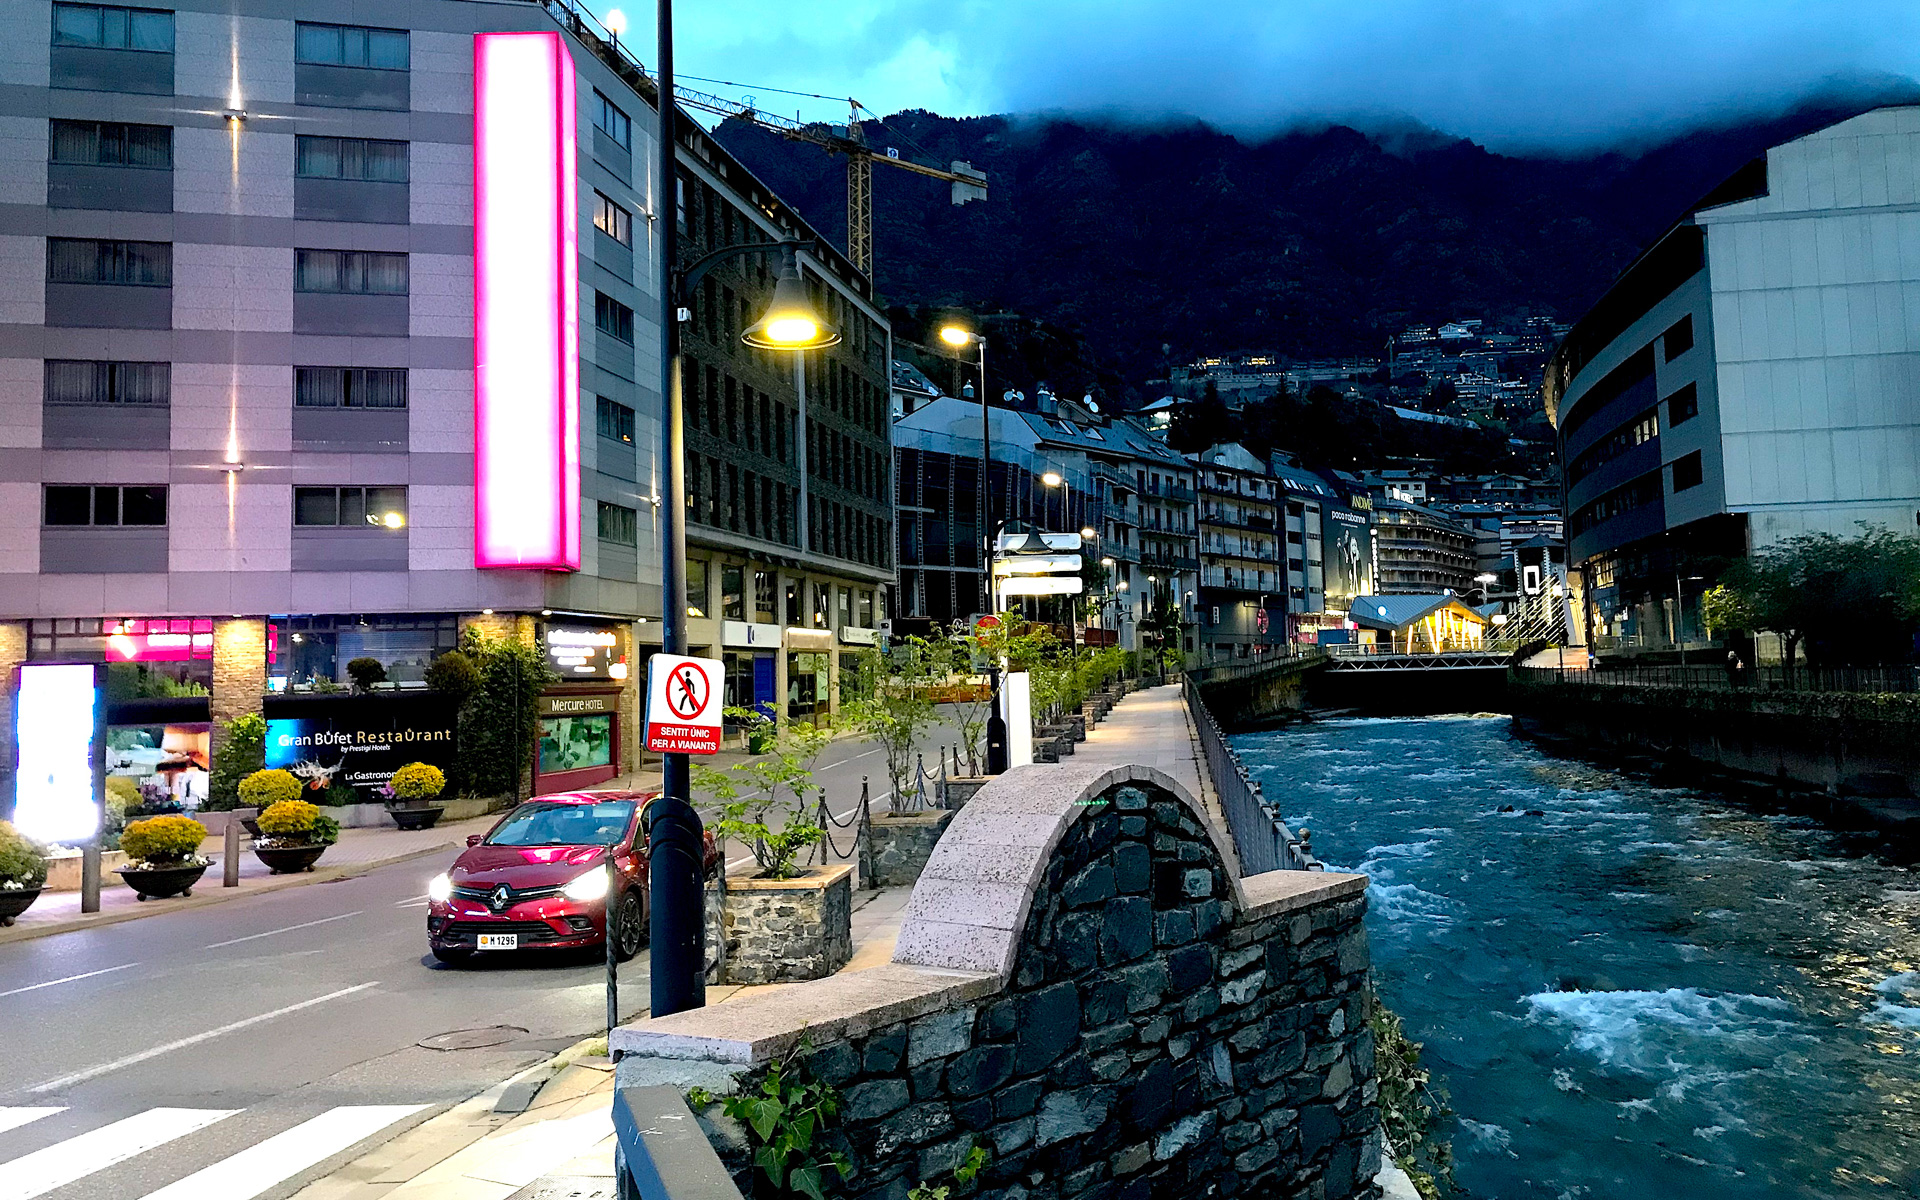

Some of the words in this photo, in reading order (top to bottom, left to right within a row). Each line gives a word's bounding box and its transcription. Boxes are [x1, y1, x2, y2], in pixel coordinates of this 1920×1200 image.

[551, 699, 585, 712] Mercure
[585, 699, 604, 710] HOTEL
[660, 726, 689, 737] SENTIT
[690, 726, 710, 738] ÚNIC
[278, 733, 311, 746] Gran
[651, 738, 669, 748] PER
[669, 739, 676, 748] A
[677, 739, 717, 751] VIANANTS
[340, 745, 348, 754] by
[349, 744, 371, 753] Prestigi
[371, 743, 391, 751] Hotels
[497, 936, 515, 945] 1296
